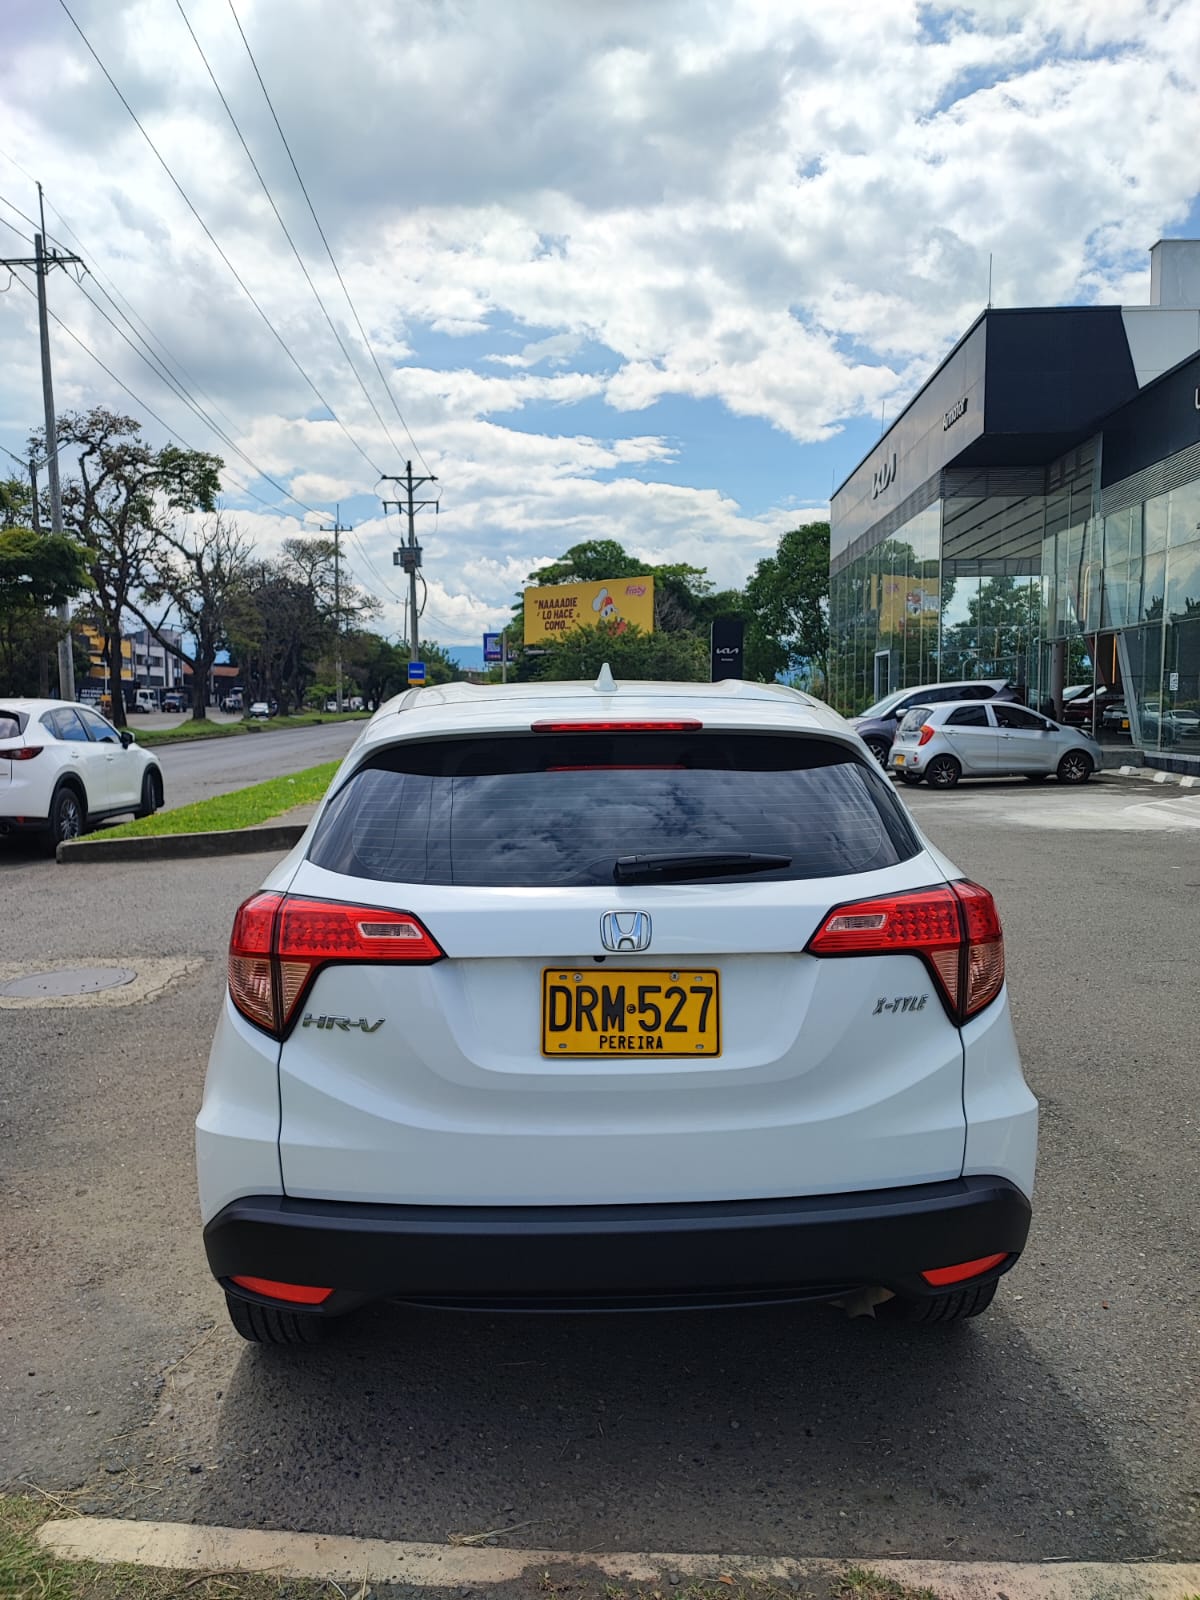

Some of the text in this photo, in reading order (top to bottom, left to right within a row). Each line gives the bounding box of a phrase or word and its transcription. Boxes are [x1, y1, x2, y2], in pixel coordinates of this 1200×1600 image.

[542, 608, 574, 620] LO HACE
[302, 1012, 386, 1033] HR-V
[599, 1035, 663, 1049] PEREIRA
